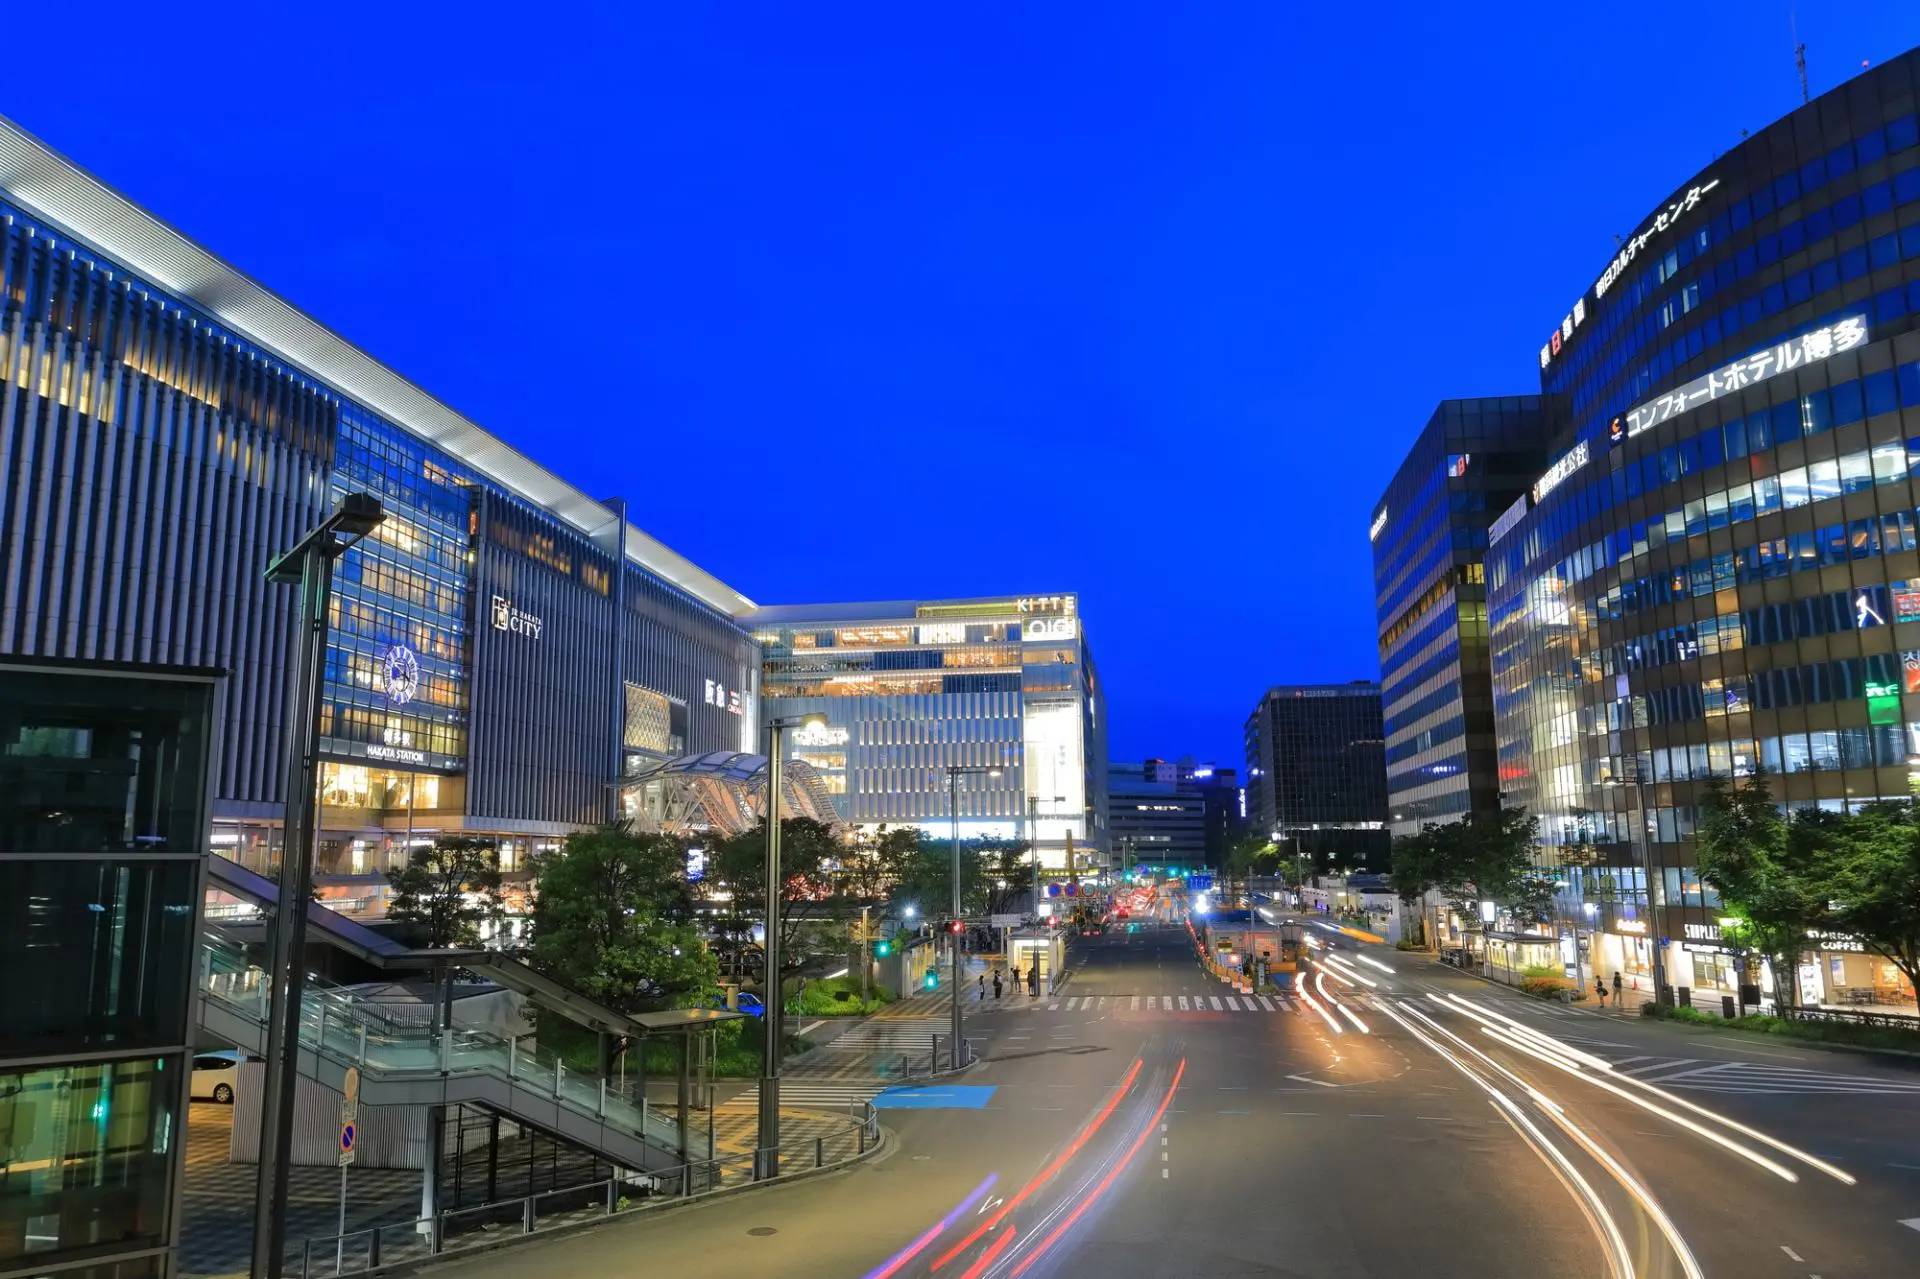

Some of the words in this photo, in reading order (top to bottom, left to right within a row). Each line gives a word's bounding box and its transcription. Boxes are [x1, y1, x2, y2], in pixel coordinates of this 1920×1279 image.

[1596, 180, 1719, 299] 朝日カルチャーセンター
[1626, 318, 1866, 438] コンフォートホテル博多
[1017, 596, 1075, 612] KITTE
[510, 616, 542, 640] CITY
[367, 744, 395, 758] HAKATA
[396, 749, 424, 763] STATION
[1820, 941, 1865, 952] COFFEE
